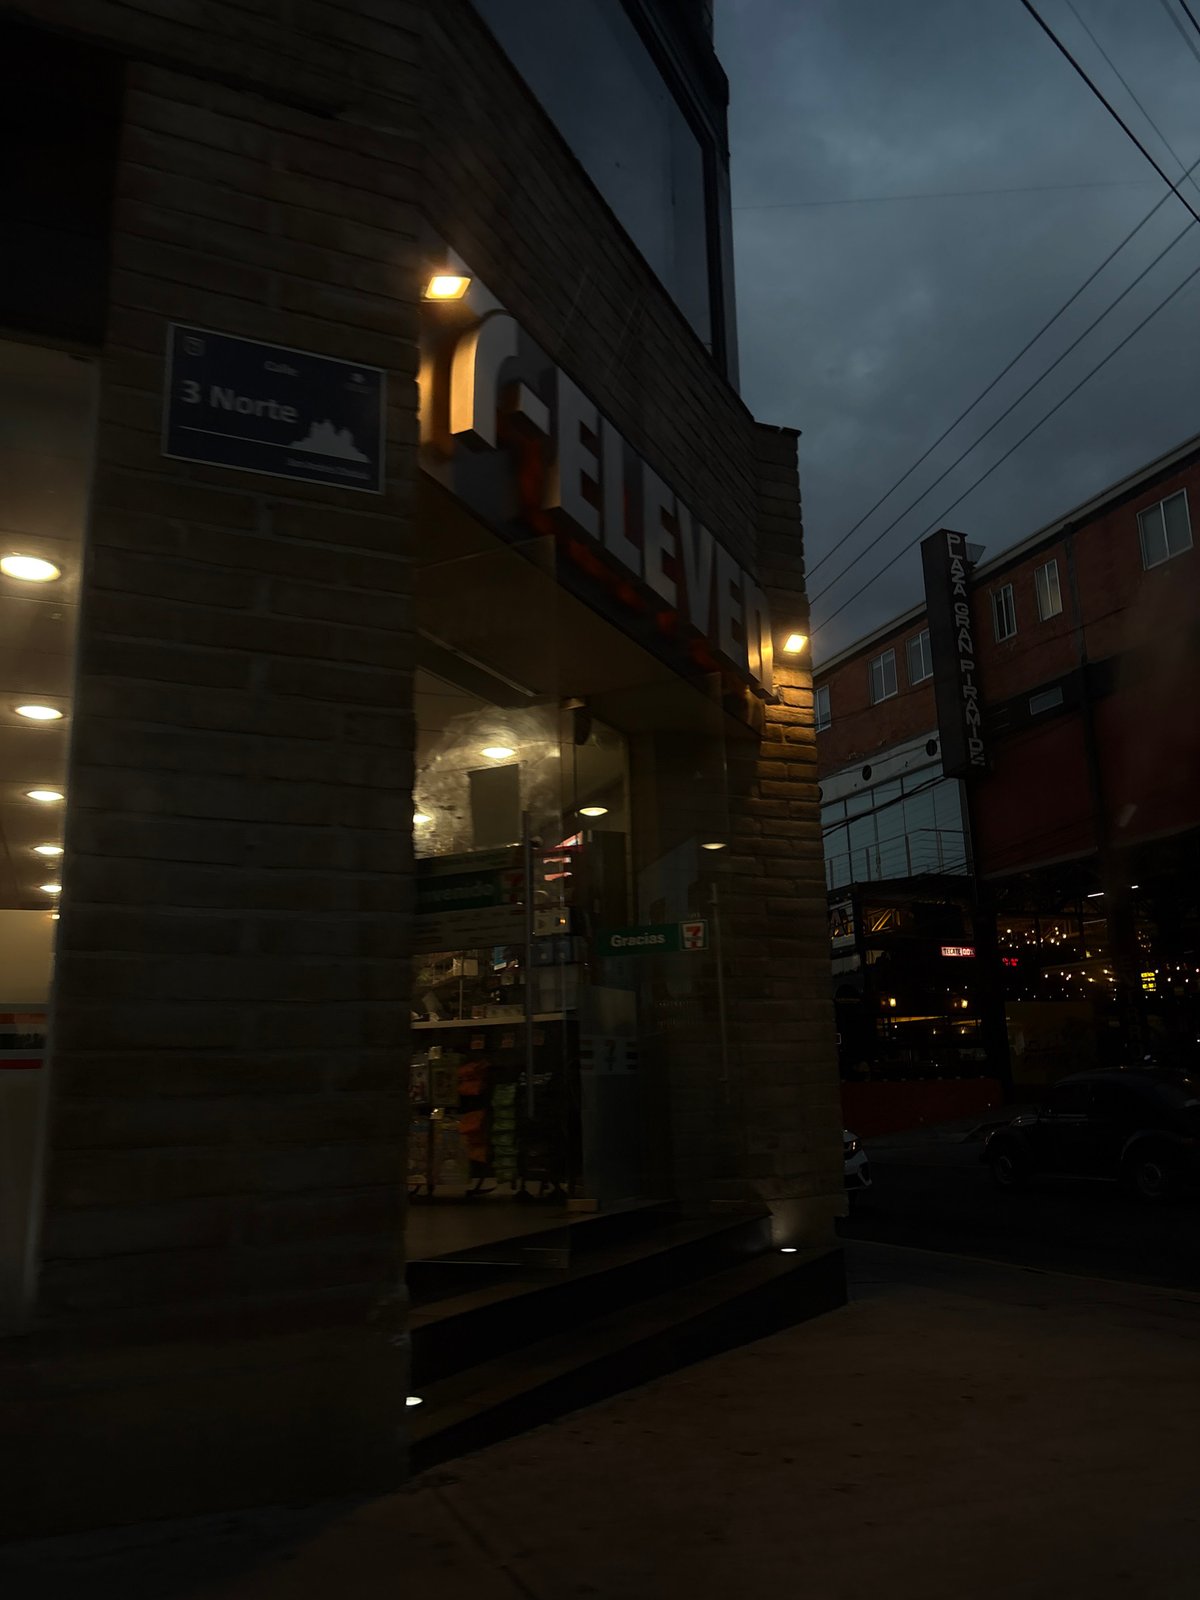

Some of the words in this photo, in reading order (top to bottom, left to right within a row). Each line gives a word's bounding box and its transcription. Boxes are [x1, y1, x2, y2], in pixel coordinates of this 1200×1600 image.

[176, 378, 203, 405] 3
[208, 384, 300, 424] Norte
[946, 532, 967, 598] PLAZA
[953, 602, 974, 655] GRAN
[610, 931, 667, 948] Gracias
